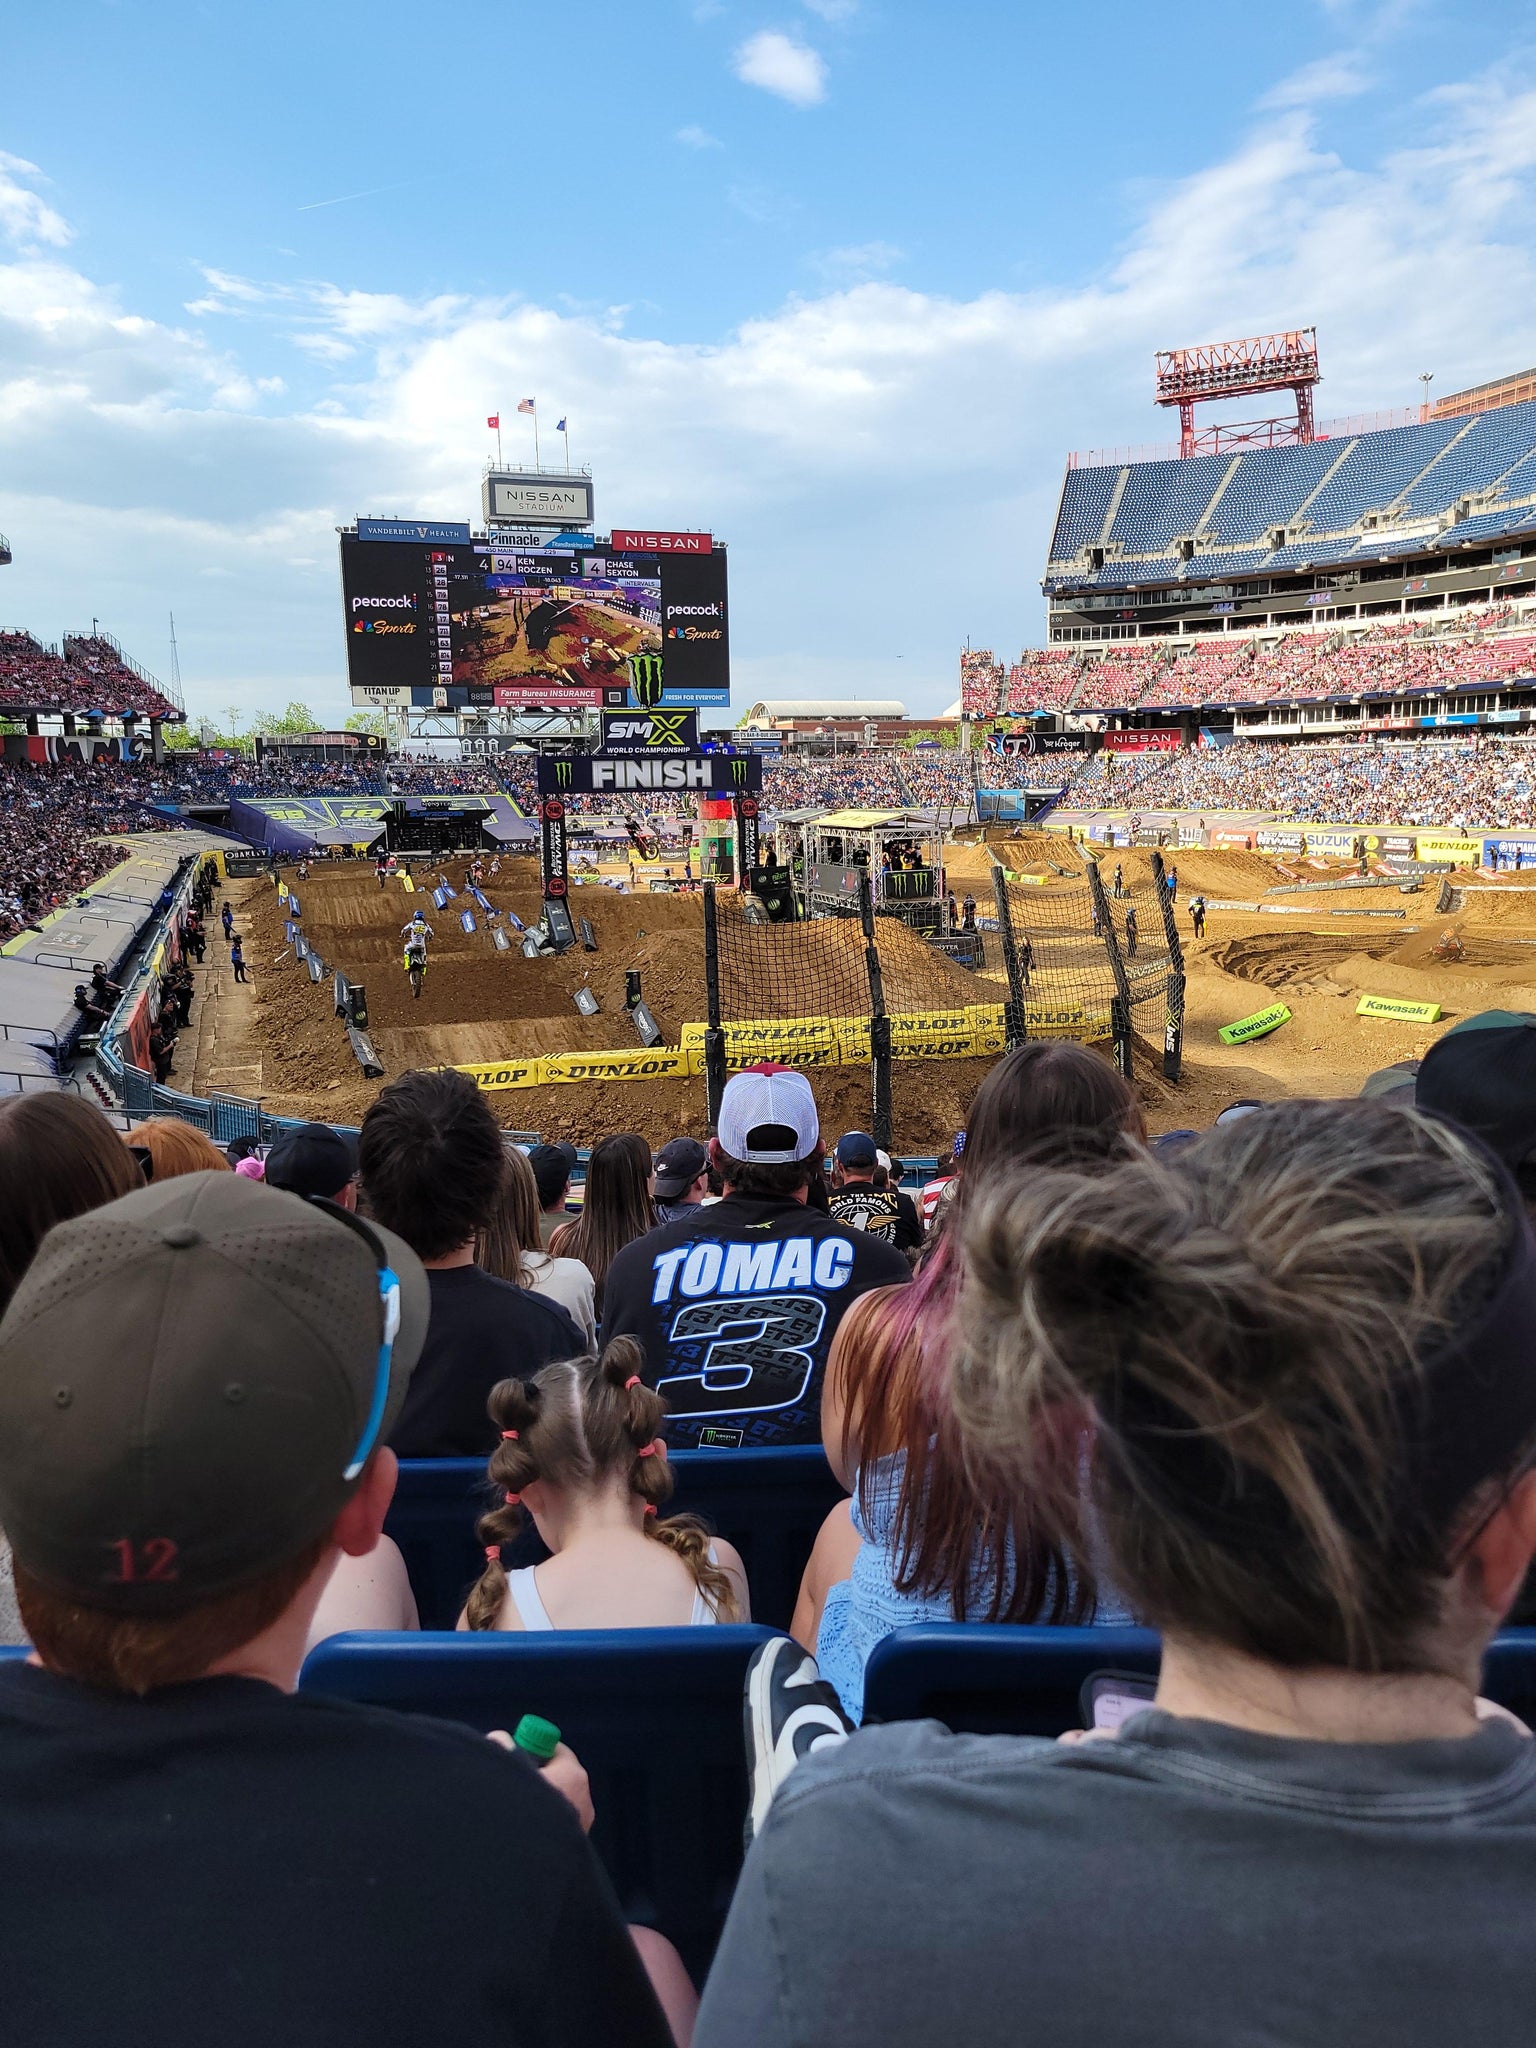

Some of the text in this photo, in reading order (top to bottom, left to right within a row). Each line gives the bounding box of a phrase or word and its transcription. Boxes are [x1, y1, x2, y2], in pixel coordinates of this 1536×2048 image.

[506, 490, 575, 503] NISSAN
[518, 502, 565, 512] STADIUM
[367, 527, 415, 536] VANDERBILT
[429, 529, 460, 538] HEALTH
[490, 532, 540, 546] Pinnacle
[625, 536, 699, 549] NISSAN
[435, 566, 445, 574] 26
[479, 558, 489, 571] 4
[497, 559, 513, 571] 94
[517, 565, 553, 574] ROCZEN
[570, 562, 579, 574] 5
[590, 562, 600, 575] 4
[606, 560, 634, 569] CHASE
[606, 569, 639, 577] SEXTON
[352, 594, 412, 613] peacock
[667, 603, 719, 620] peacock
[373, 620, 417, 636] Sports
[685, 627, 722, 642] Sports
[363, 687, 400, 696] TITAN UP
[501, 689, 596, 698] Farm Bureau INSURANCE
[606, 715, 688, 746] SMX
[1054, 736, 1081, 751] Kroger
[1113, 733, 1171, 744] NISSAN
[606, 746, 691, 754] WORLD CHAMPIONSHIP
[591, 759, 713, 789] FINISH
[264, 809, 308, 820] 38
[339, 809, 385, 818] 18
[1430, 842, 1478, 850] DUNLOP
[1365, 999, 1430, 1015] Kawasaki
[1228, 1009, 1283, 1039] Kawasaki
[566, 1059, 679, 1078] DUNLOP
[855, 1197, 892, 1215] FAMOUS
[651, 1237, 855, 1304] TOMAC
[655, 1294, 827, 1420] 3
[110, 1537, 179, 1582] 12
